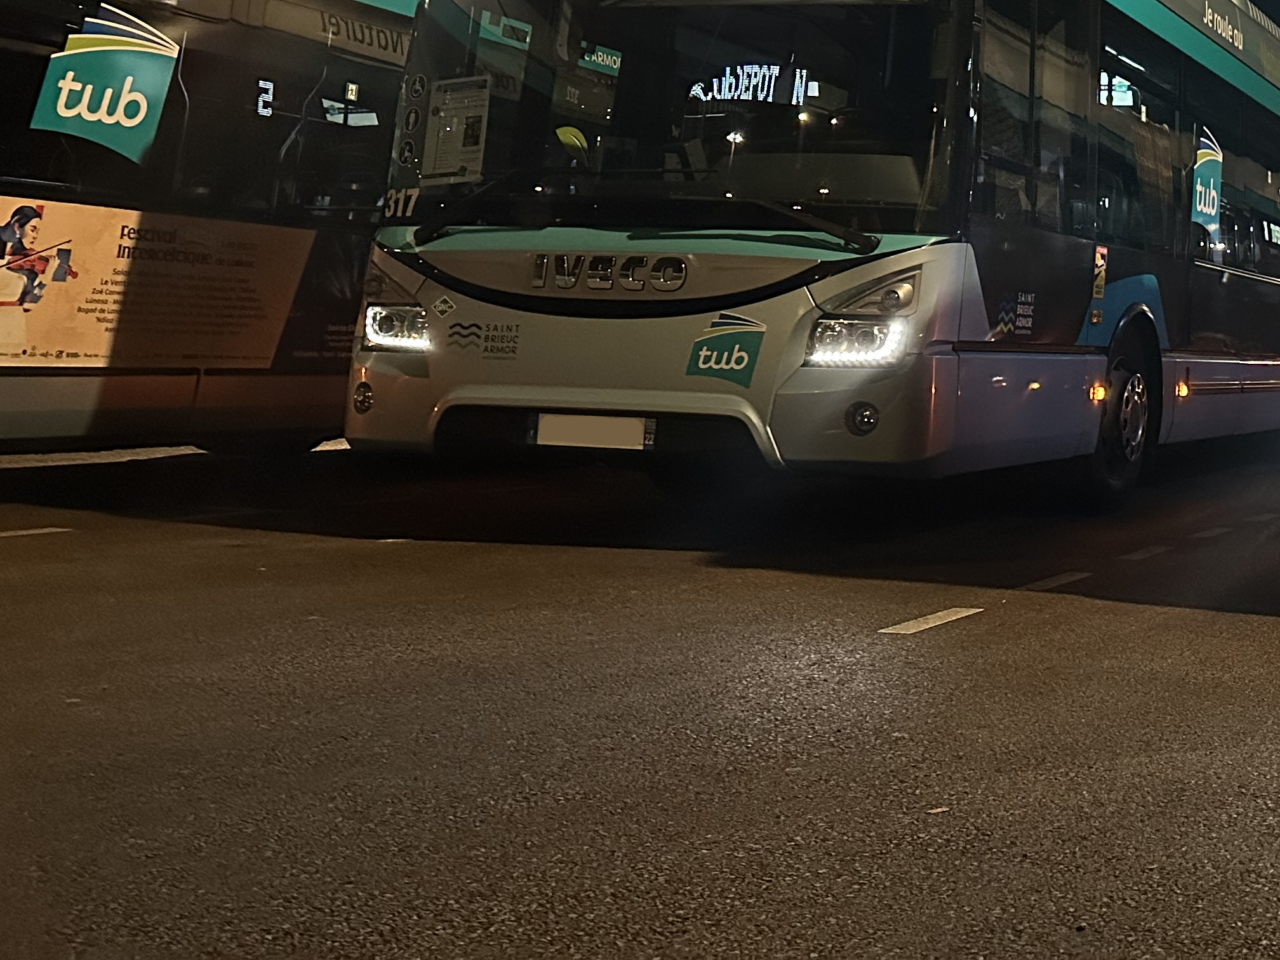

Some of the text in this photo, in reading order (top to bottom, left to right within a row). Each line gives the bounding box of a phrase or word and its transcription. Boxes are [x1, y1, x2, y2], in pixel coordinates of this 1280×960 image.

[1202, 0, 1244, 51] Je roule au
[56, 71, 148, 127] tub
[384, 187, 421, 218] 317
[1196, 177, 1218, 217] tub
[531, 253, 690, 292] IVECO
[1017, 291, 1035, 303] SAINT
[484, 334, 520, 344] BRIEUC
[485, 323, 520, 333] SAINT
[482, 345, 517, 355] ARMOR
[697, 342, 749, 373] tub
